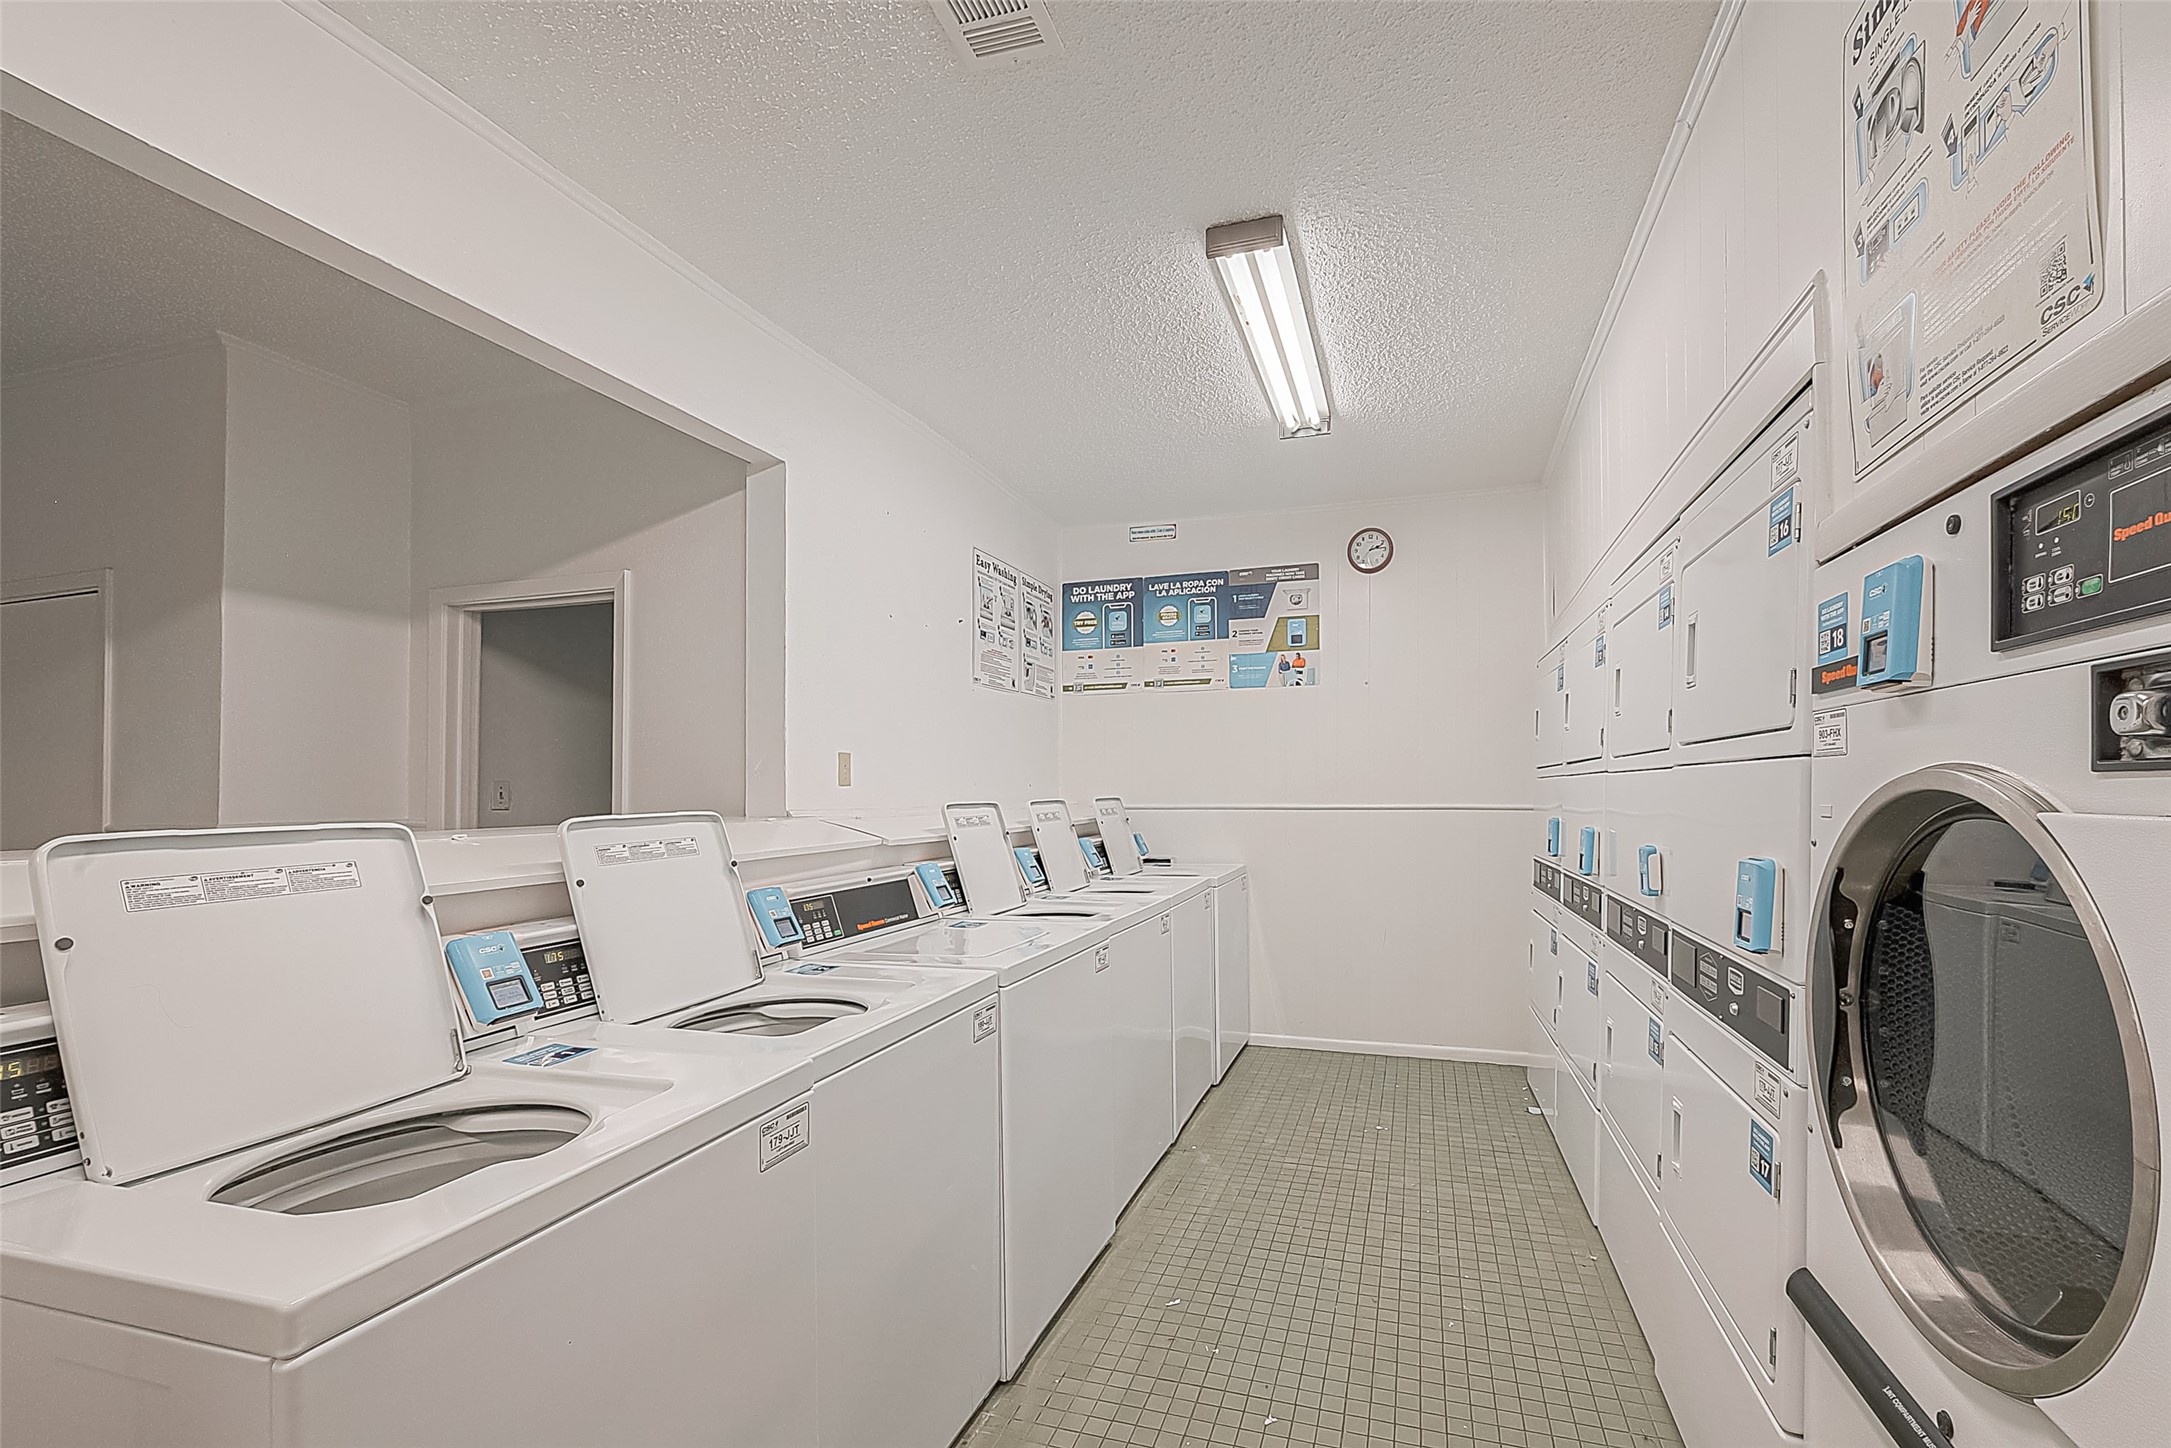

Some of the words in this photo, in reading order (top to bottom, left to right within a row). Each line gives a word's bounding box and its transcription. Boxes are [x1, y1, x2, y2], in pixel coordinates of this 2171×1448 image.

[1853, 0, 1900, 65] Sim
[1870, 0, 1912, 66] SINGLE-L
[2041, 285, 2081, 325] CSC
[1780, 519, 1789, 539] 16
[2113, 515, 2153, 542] Speed
[976, 553, 992, 574] Easy
[992, 561, 1017, 587] Washing
[1072, 586, 1087, 595] DO
[1088, 583, 1133, 594] LAUNDRY
[1148, 582, 1169, 591] LAVE
[1182, 580, 1205, 588] ROPA
[1206, 578, 1224, 587] CON
[1070, 594, 1094, 603] WITH
[1095, 592, 1115, 601] THE
[1116, 591, 1135, 600] APP
[1232, 594, 1237, 603] 1
[1232, 630, 1238, 638] 2
[1832, 627, 1844, 648] 18
[1232, 665, 1238, 673] 3
[1821, 665, 1846, 685] Speed
[1819, 728, 1842, 739] 903-FHX
[479, 946, 497, 954] CSC
[769, 1124, 800, 1149] 179-JJT
[1760, 1159, 1770, 1179] 17
[1892, 1398, 1927, 1438] COMPARTMENT
